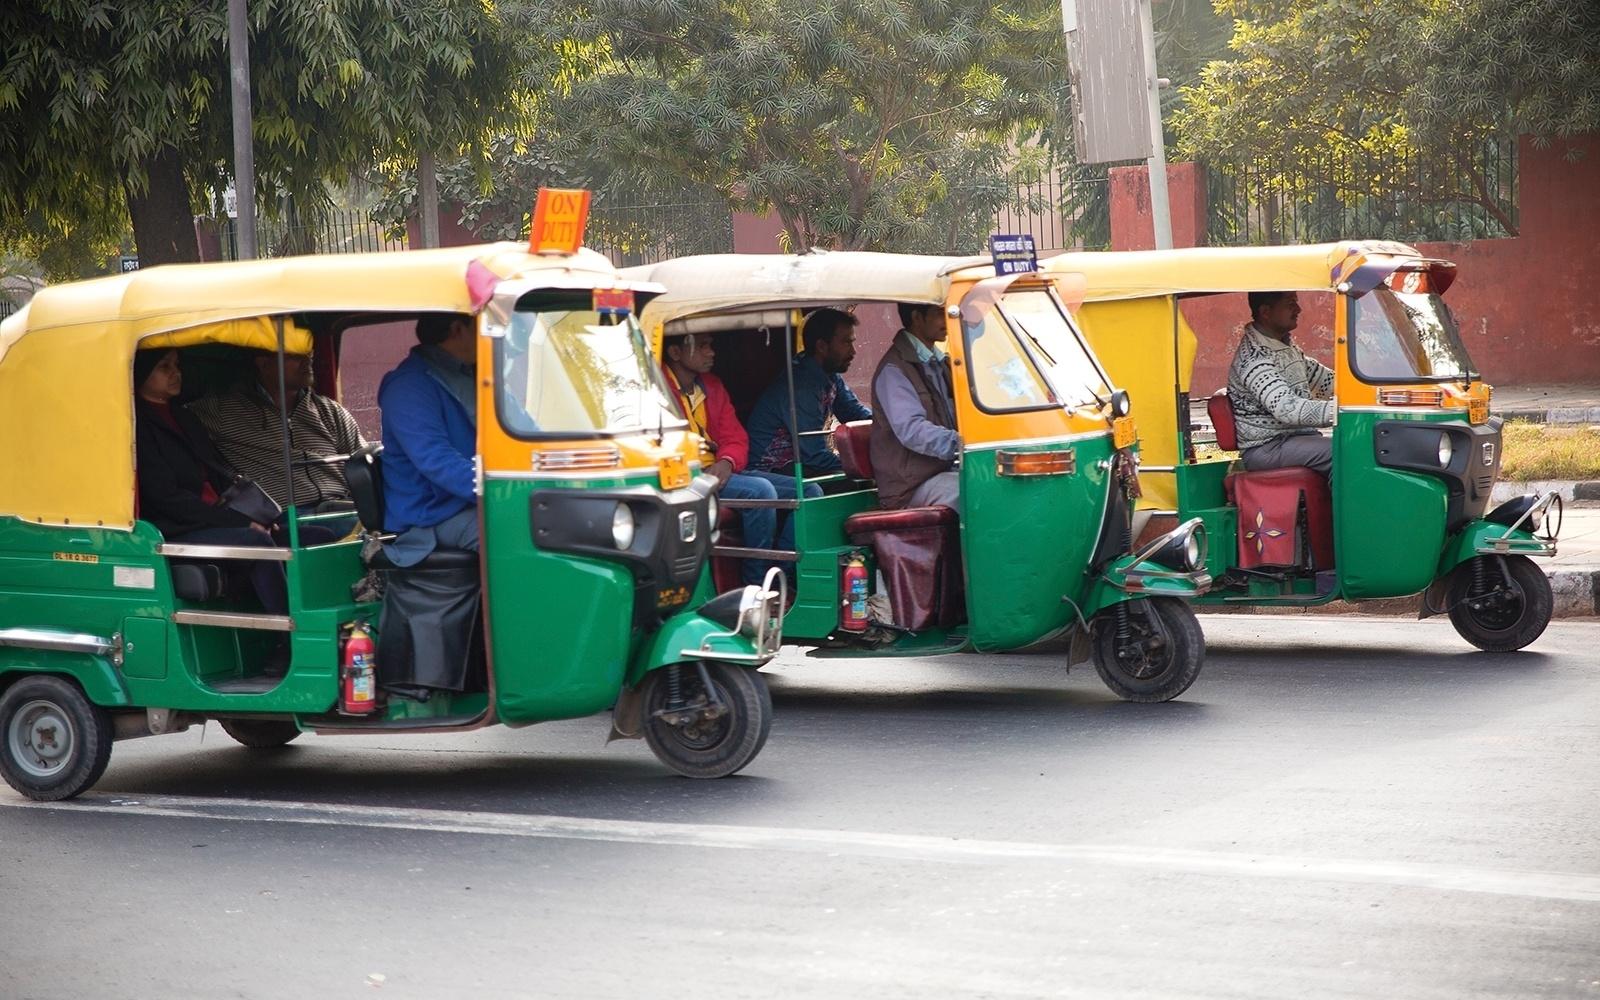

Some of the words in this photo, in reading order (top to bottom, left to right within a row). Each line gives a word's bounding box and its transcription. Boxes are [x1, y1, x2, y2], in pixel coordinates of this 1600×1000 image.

[551, 193, 578, 214] ON
[541, 221, 578, 242] DUTY
[1003, 261, 1013, 273] ON
[1013, 260, 1029, 272] DUTY
